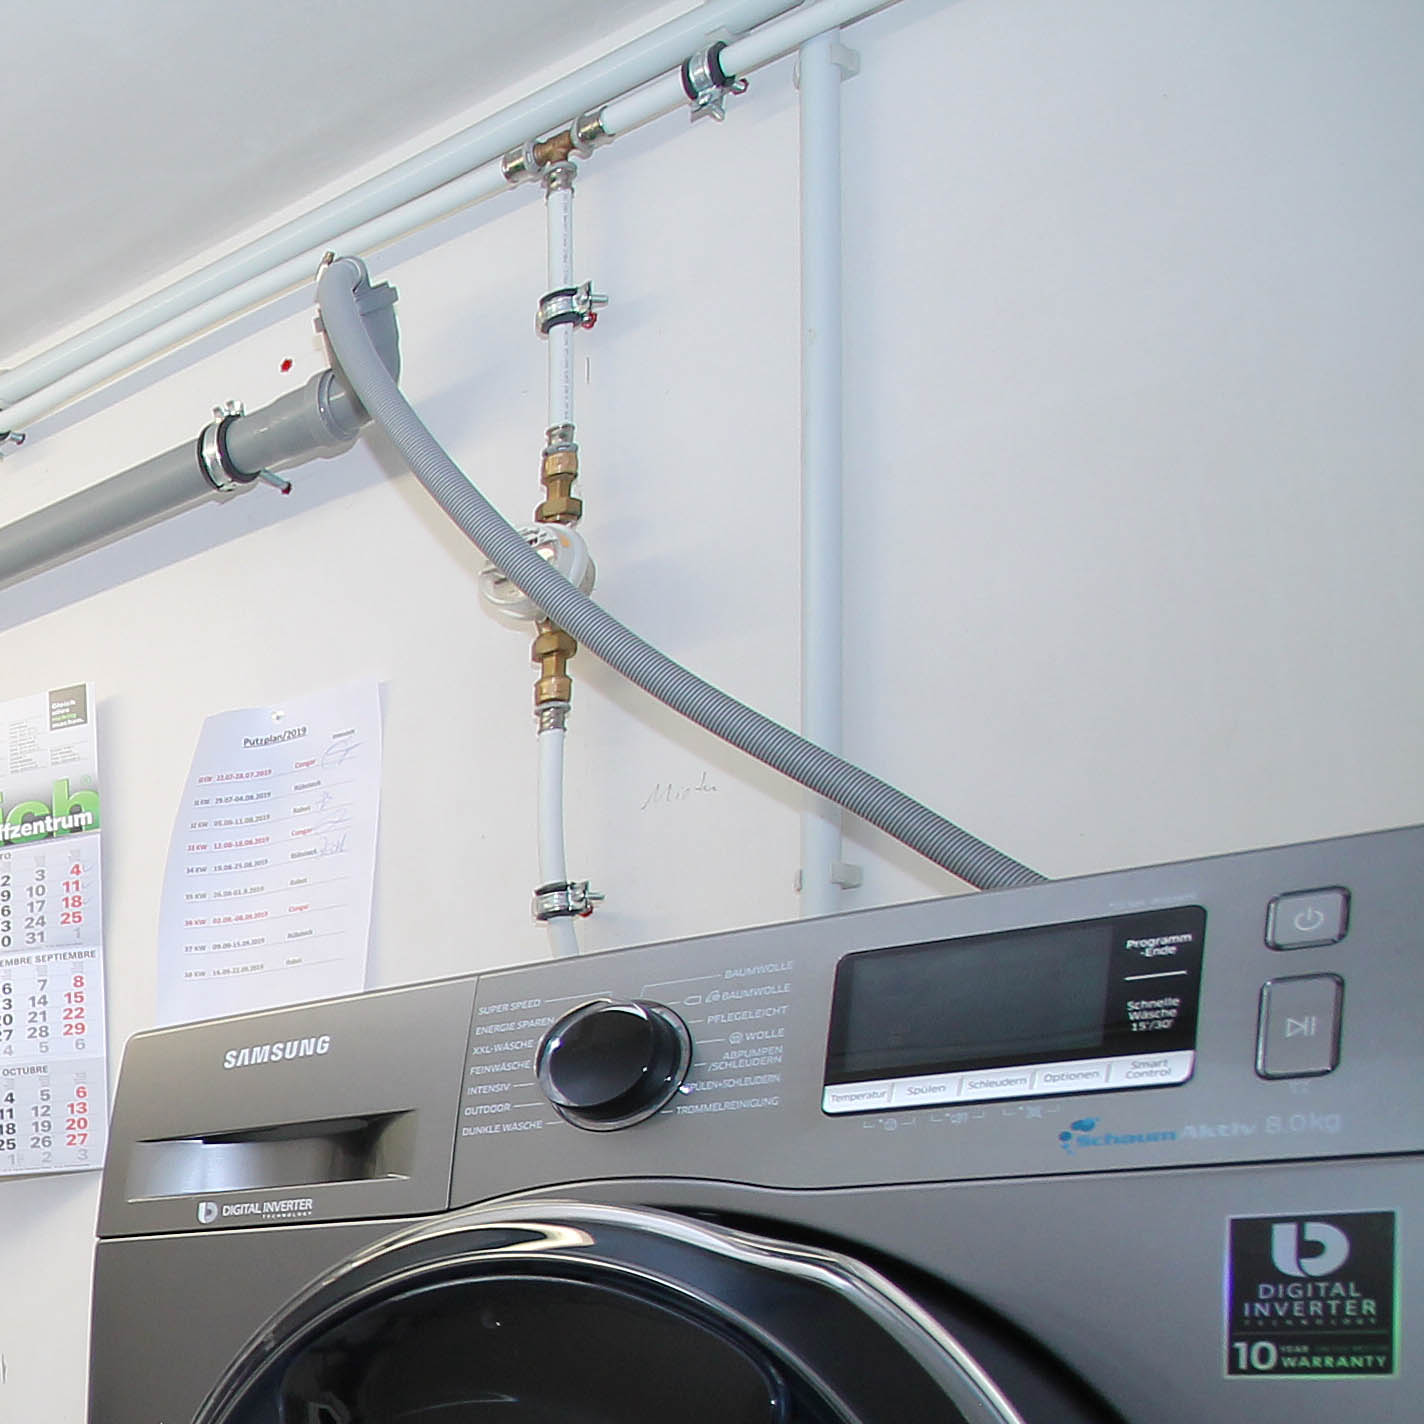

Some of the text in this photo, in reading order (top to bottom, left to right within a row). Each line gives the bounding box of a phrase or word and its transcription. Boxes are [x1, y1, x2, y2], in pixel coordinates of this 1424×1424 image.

[243, 727, 306, 746] Putzplan/2019
[1, 875, 10, 887] 2
[70, 864, 81, 875] 4
[1, 890, 11, 902] 9
[63, 880, 79, 893] 11
[62, 895, 82, 908] 18
[61, 911, 82, 924] 25
[1126, 934, 1192, 949] Programm
[34, 950, 96, 964] SEPTIEMBRE
[724, 960, 793, 979] BAUMWOLLE
[2, 983, 12, 995] 6
[73, 976, 84, 987] 8
[722, 984, 791, 1001] BAUMWOLLE
[65, 991, 84, 1004] 15
[1127, 998, 1180, 1010] Schnelle
[63, 1007, 84, 1020] 22
[478, 999, 541, 1015] SUPER SPEED
[707, 1005, 790, 1024] PFLEGELEICHT
[64, 1023, 85, 1035] 29
[476, 1017, 554, 1035] ENERGIE SPAREN
[744, 1028, 784, 1040] WOLLE
[223, 1035, 331, 1069] SAMSUNG
[723, 1046, 784, 1060] ABPUMPEN
[2, 1065, 48, 1077] OCTUBRE
[1131, 1059, 1168, 1069] Smart
[1125, 1068, 1172, 1079] Control
[468, 1084, 511, 1095] INTENSIV
[831, 1069, 1100, 1104] Temperatur Spülen Schleudern Optionen
[4, 1093, 15, 1103] 4
[76, 1086, 87, 1098] 6
[68, 1102, 87, 1114] 13
[464, 1103, 511, 1115] OUTDOOR
[676, 1096, 780, 1114] TROMMELREINIGUNG
[66, 1118, 87, 1130] 20
[462, 1124, 501, 1137] DUNKLE
[66, 1133, 88, 1146] 27
[222, 1198, 313, 1217] DIGITAL INVERTER
[1258, 1281, 1362, 1299] DIGITAL
[1244, 1299, 1377, 1317] INVERTER
[1234, 1341, 1277, 1370] 10
[1281, 1355, 1386, 1368] WARRANTY
